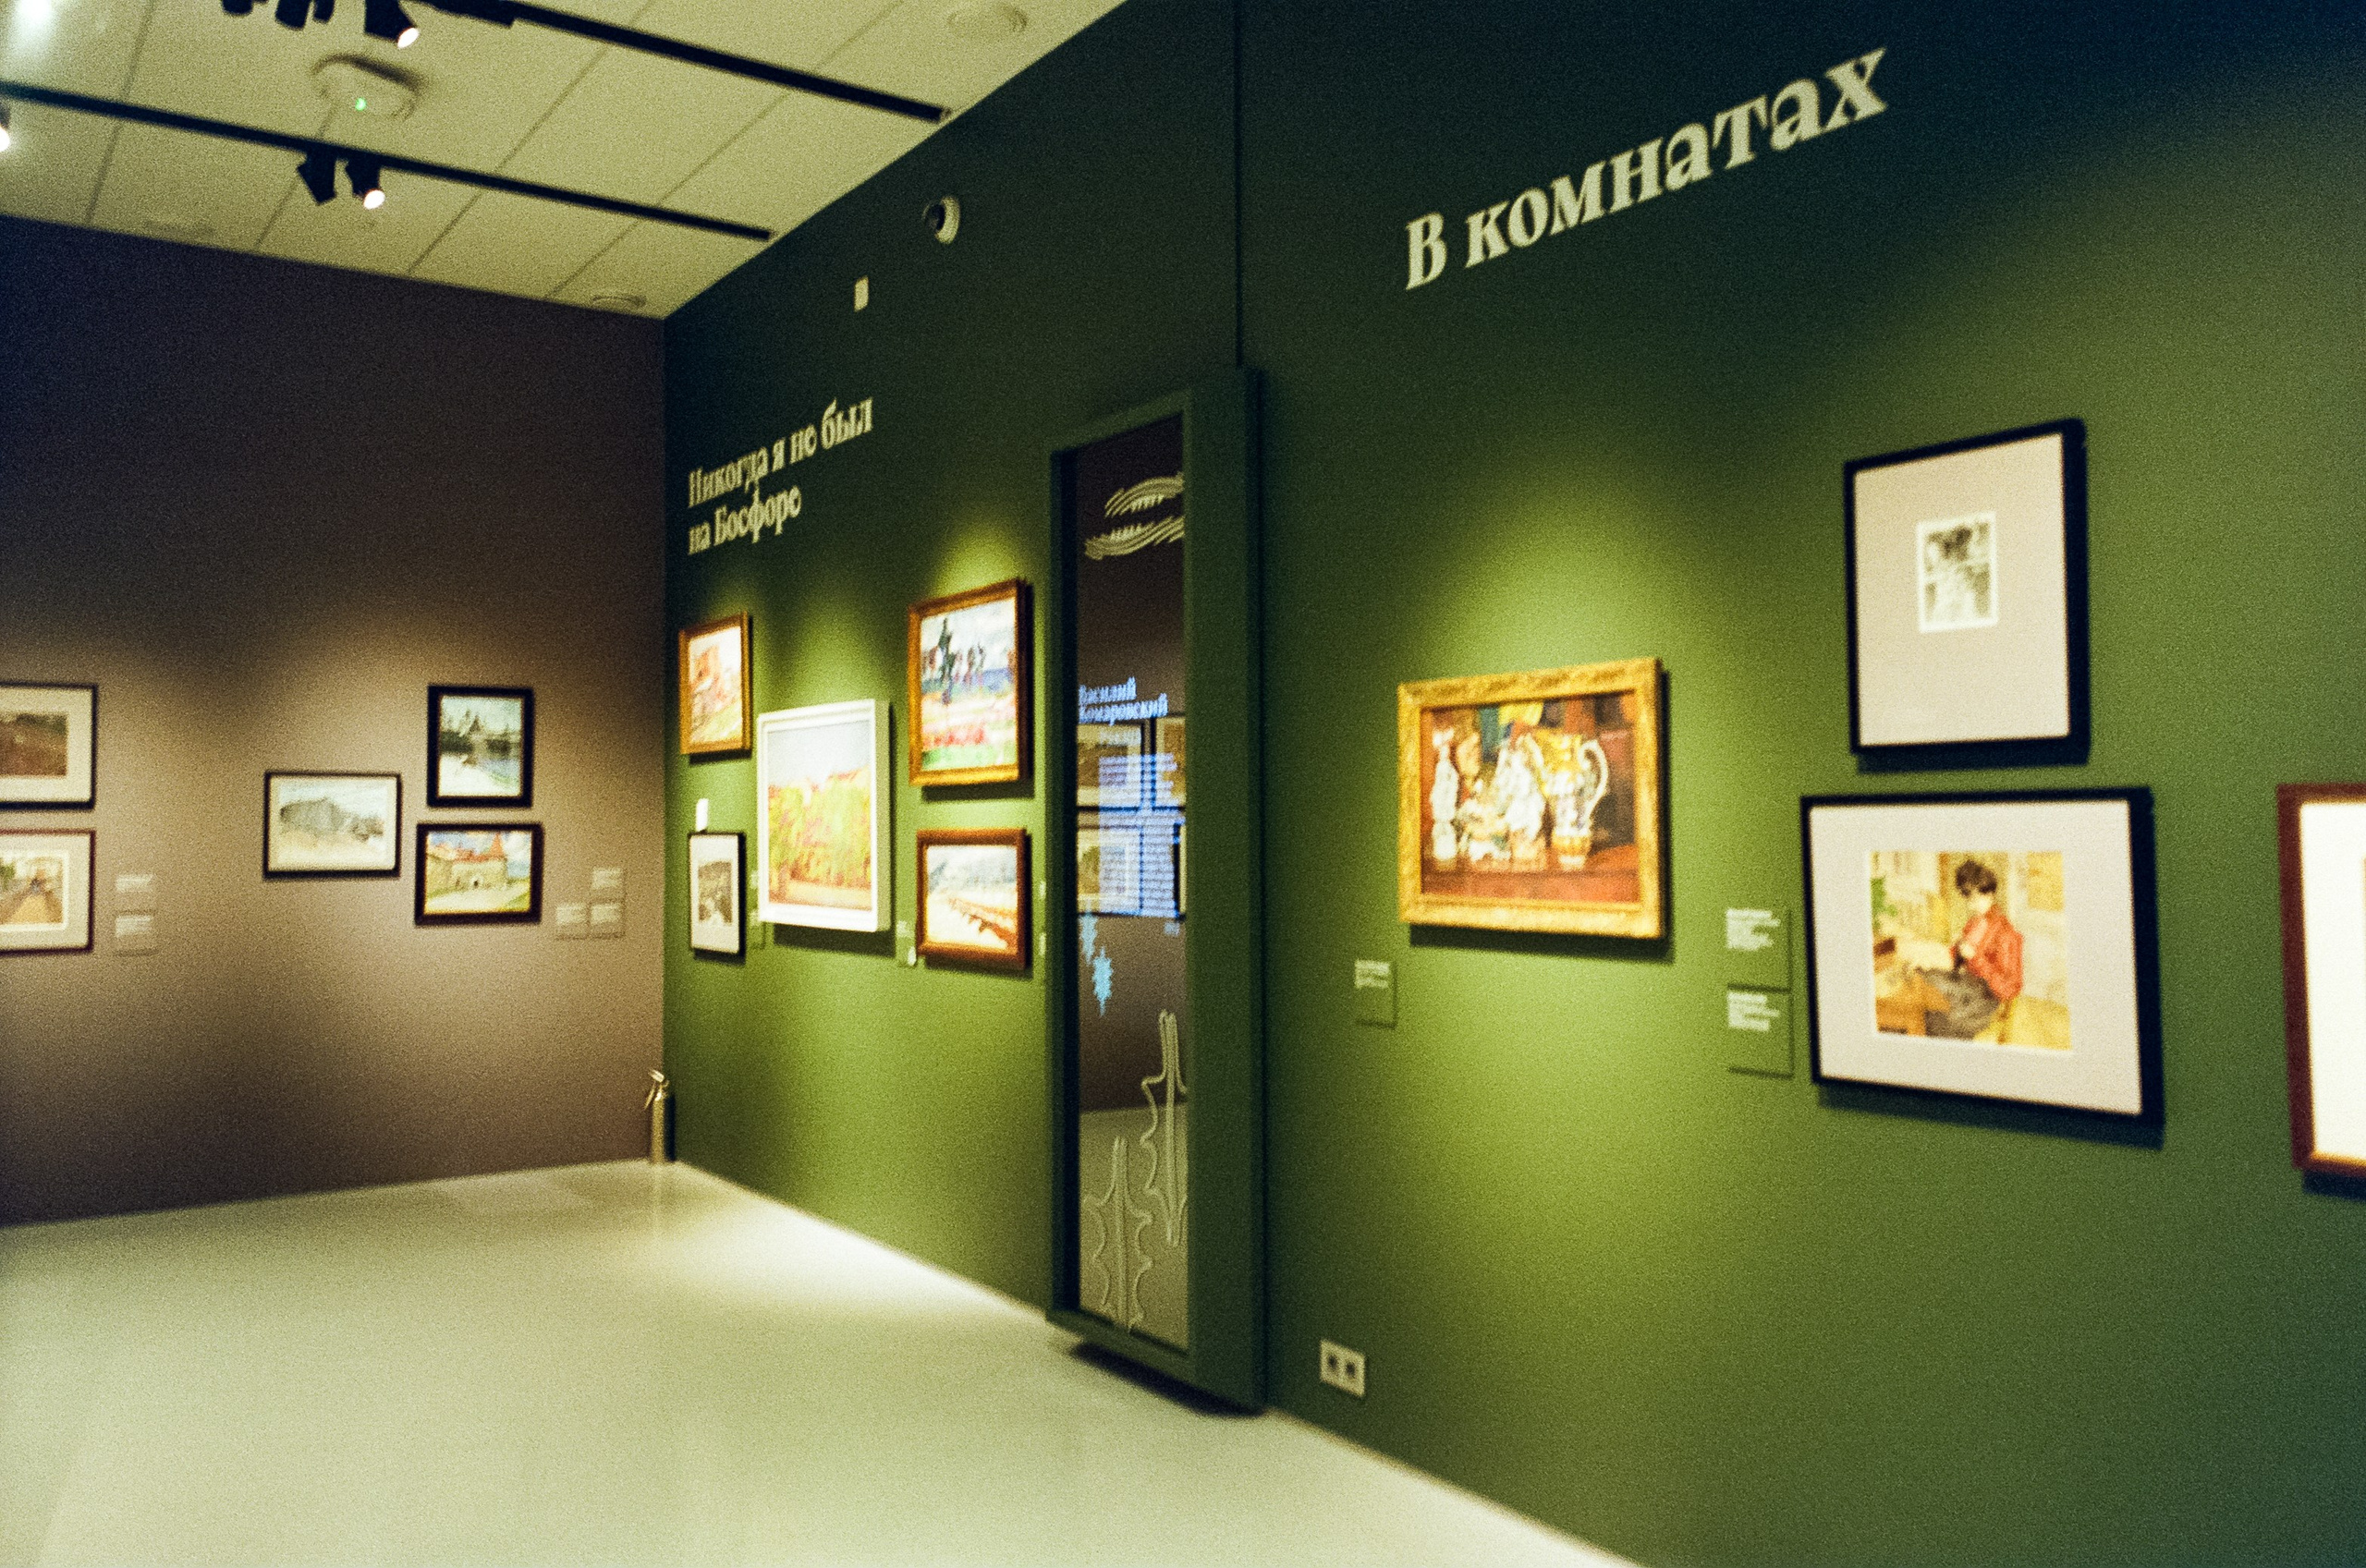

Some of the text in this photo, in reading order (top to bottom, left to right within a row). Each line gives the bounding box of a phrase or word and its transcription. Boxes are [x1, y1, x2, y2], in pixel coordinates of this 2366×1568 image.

[1406, 47, 1887, 291] В комнатах
[689, 397, 873, 507] Никогда я не был
[689, 484, 801, 554] на Босфоре
